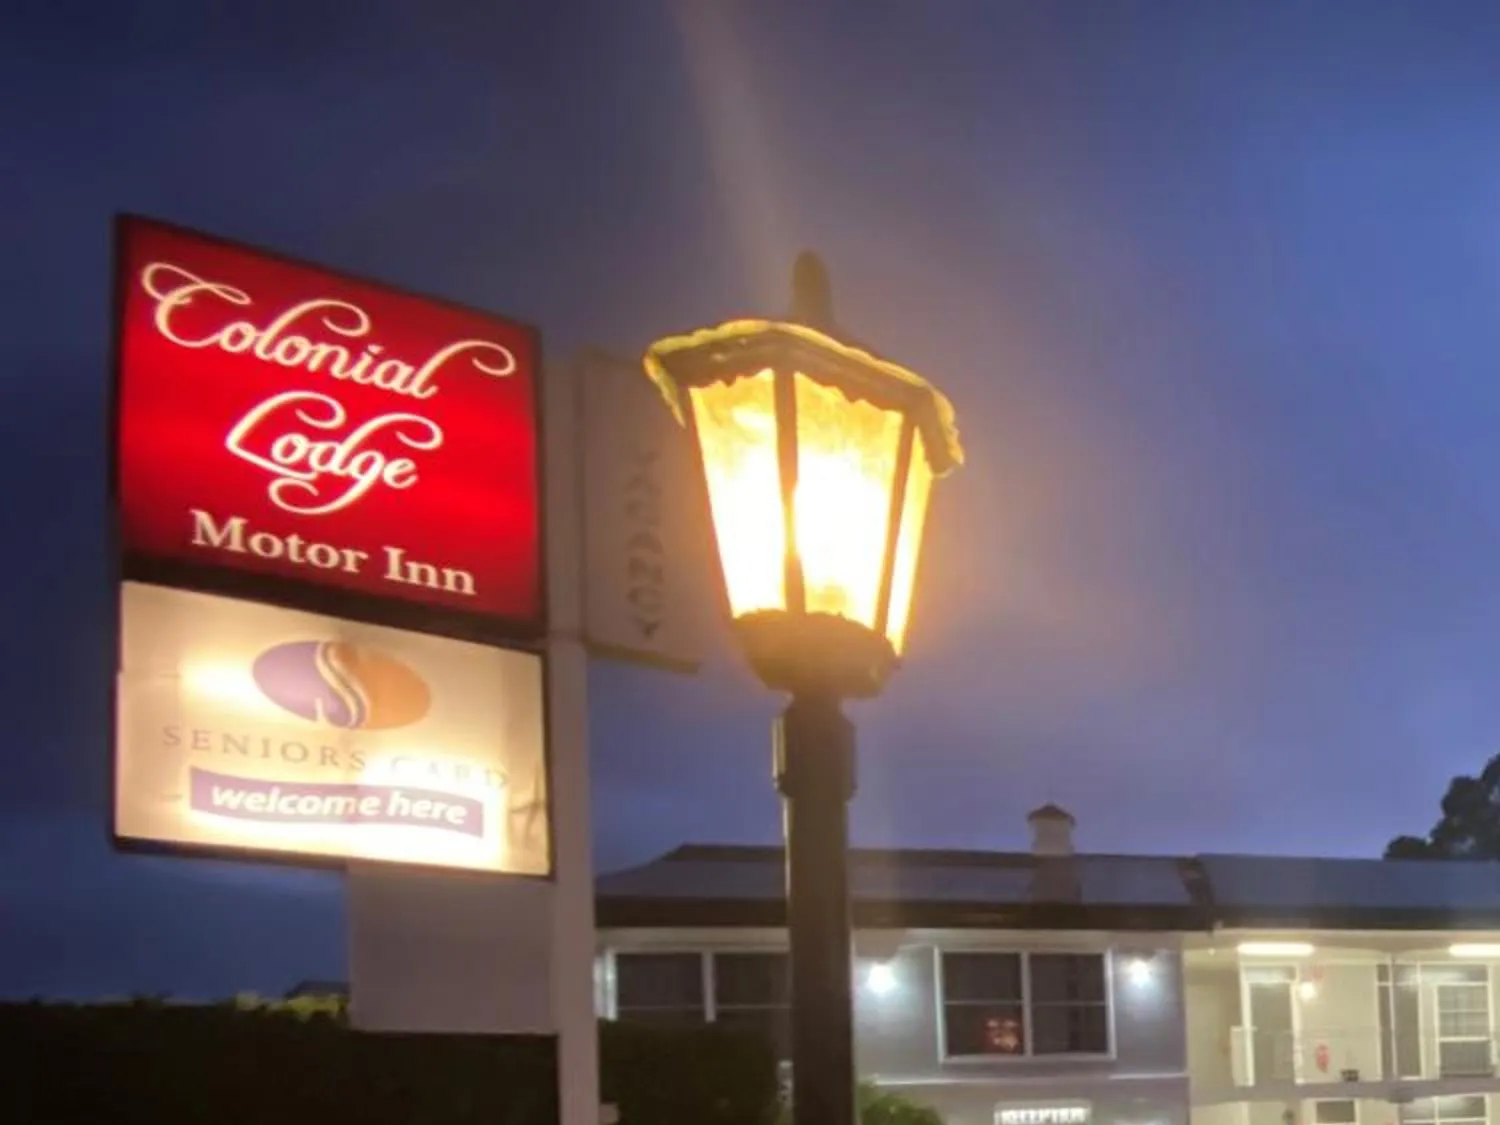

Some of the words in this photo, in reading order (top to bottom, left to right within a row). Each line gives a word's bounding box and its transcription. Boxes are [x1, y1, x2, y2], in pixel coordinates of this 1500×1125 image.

[141, 261, 517, 399] Colonial
[225, 390, 444, 515] Lodge
[189, 508, 369, 574] Motor
[383, 545, 478, 596] Inn
[162, 726, 367, 771] SENIORS
[211, 783, 381, 816] welcome
[386, 789, 468, 826] here
